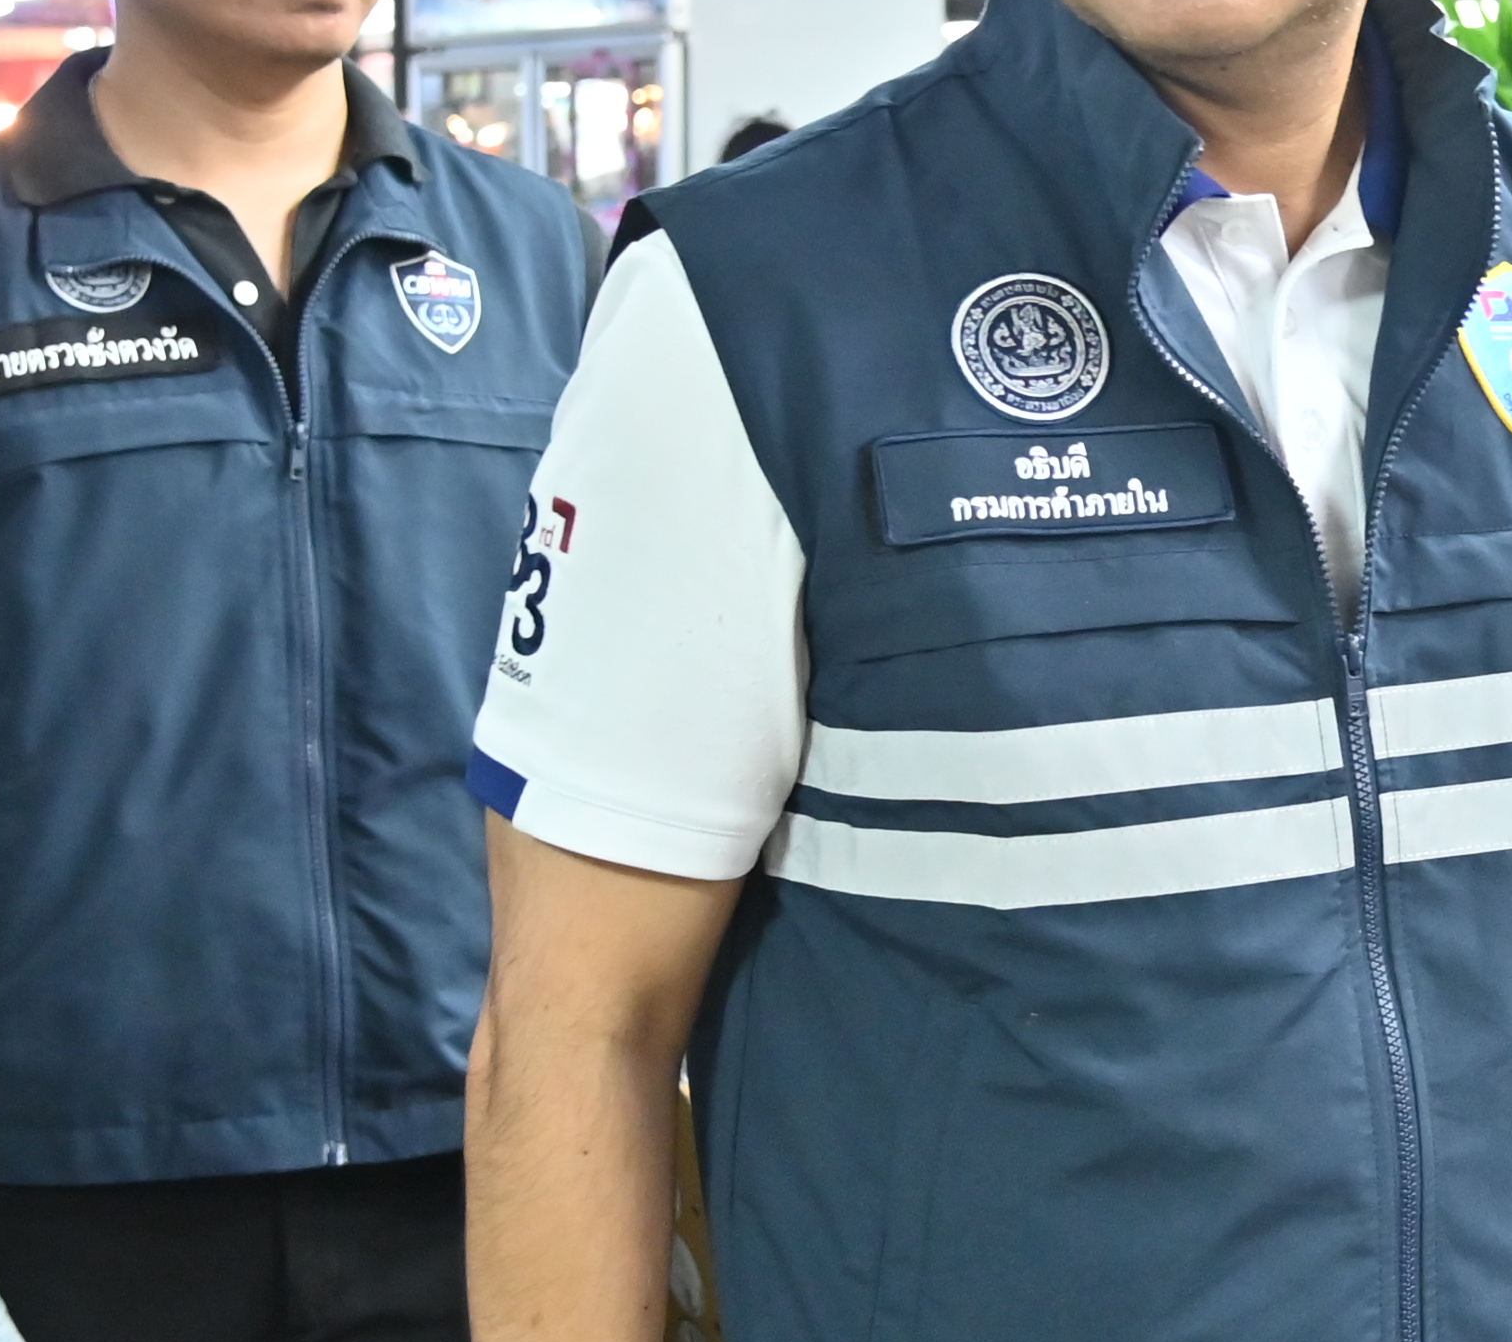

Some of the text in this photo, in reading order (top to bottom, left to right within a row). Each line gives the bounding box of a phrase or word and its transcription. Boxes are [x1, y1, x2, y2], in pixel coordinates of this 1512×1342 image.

[1014, 441, 1091, 480] อธิบดี
[950, 477, 1169, 523] กรมการค้าภายใน
